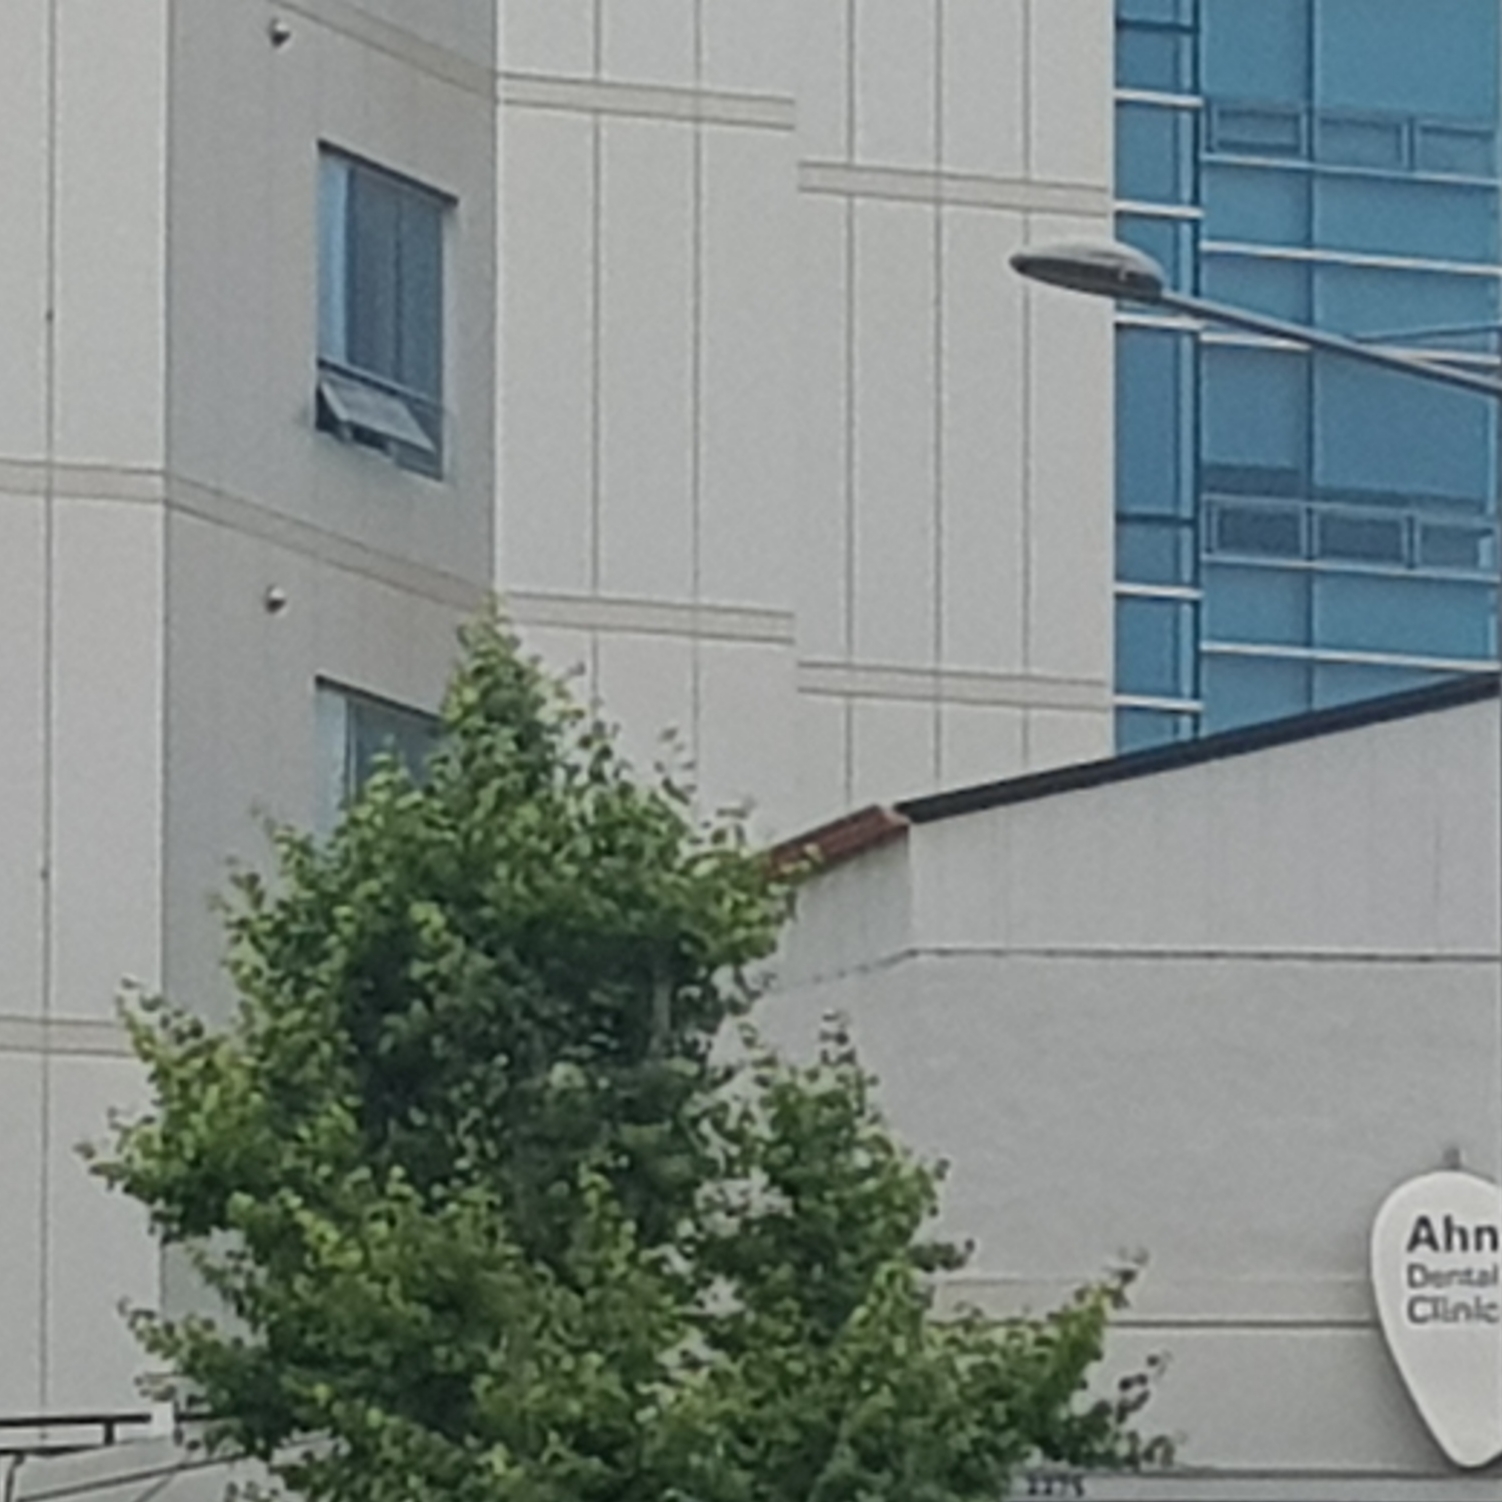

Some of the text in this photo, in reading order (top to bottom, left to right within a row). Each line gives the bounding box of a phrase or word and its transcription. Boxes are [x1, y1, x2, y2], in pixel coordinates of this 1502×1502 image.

[1406, 1214, 1499, 1252] Ahn
[1407, 1262, 1498, 1290] Dental
[1407, 1296, 1499, 1325] Clinic
